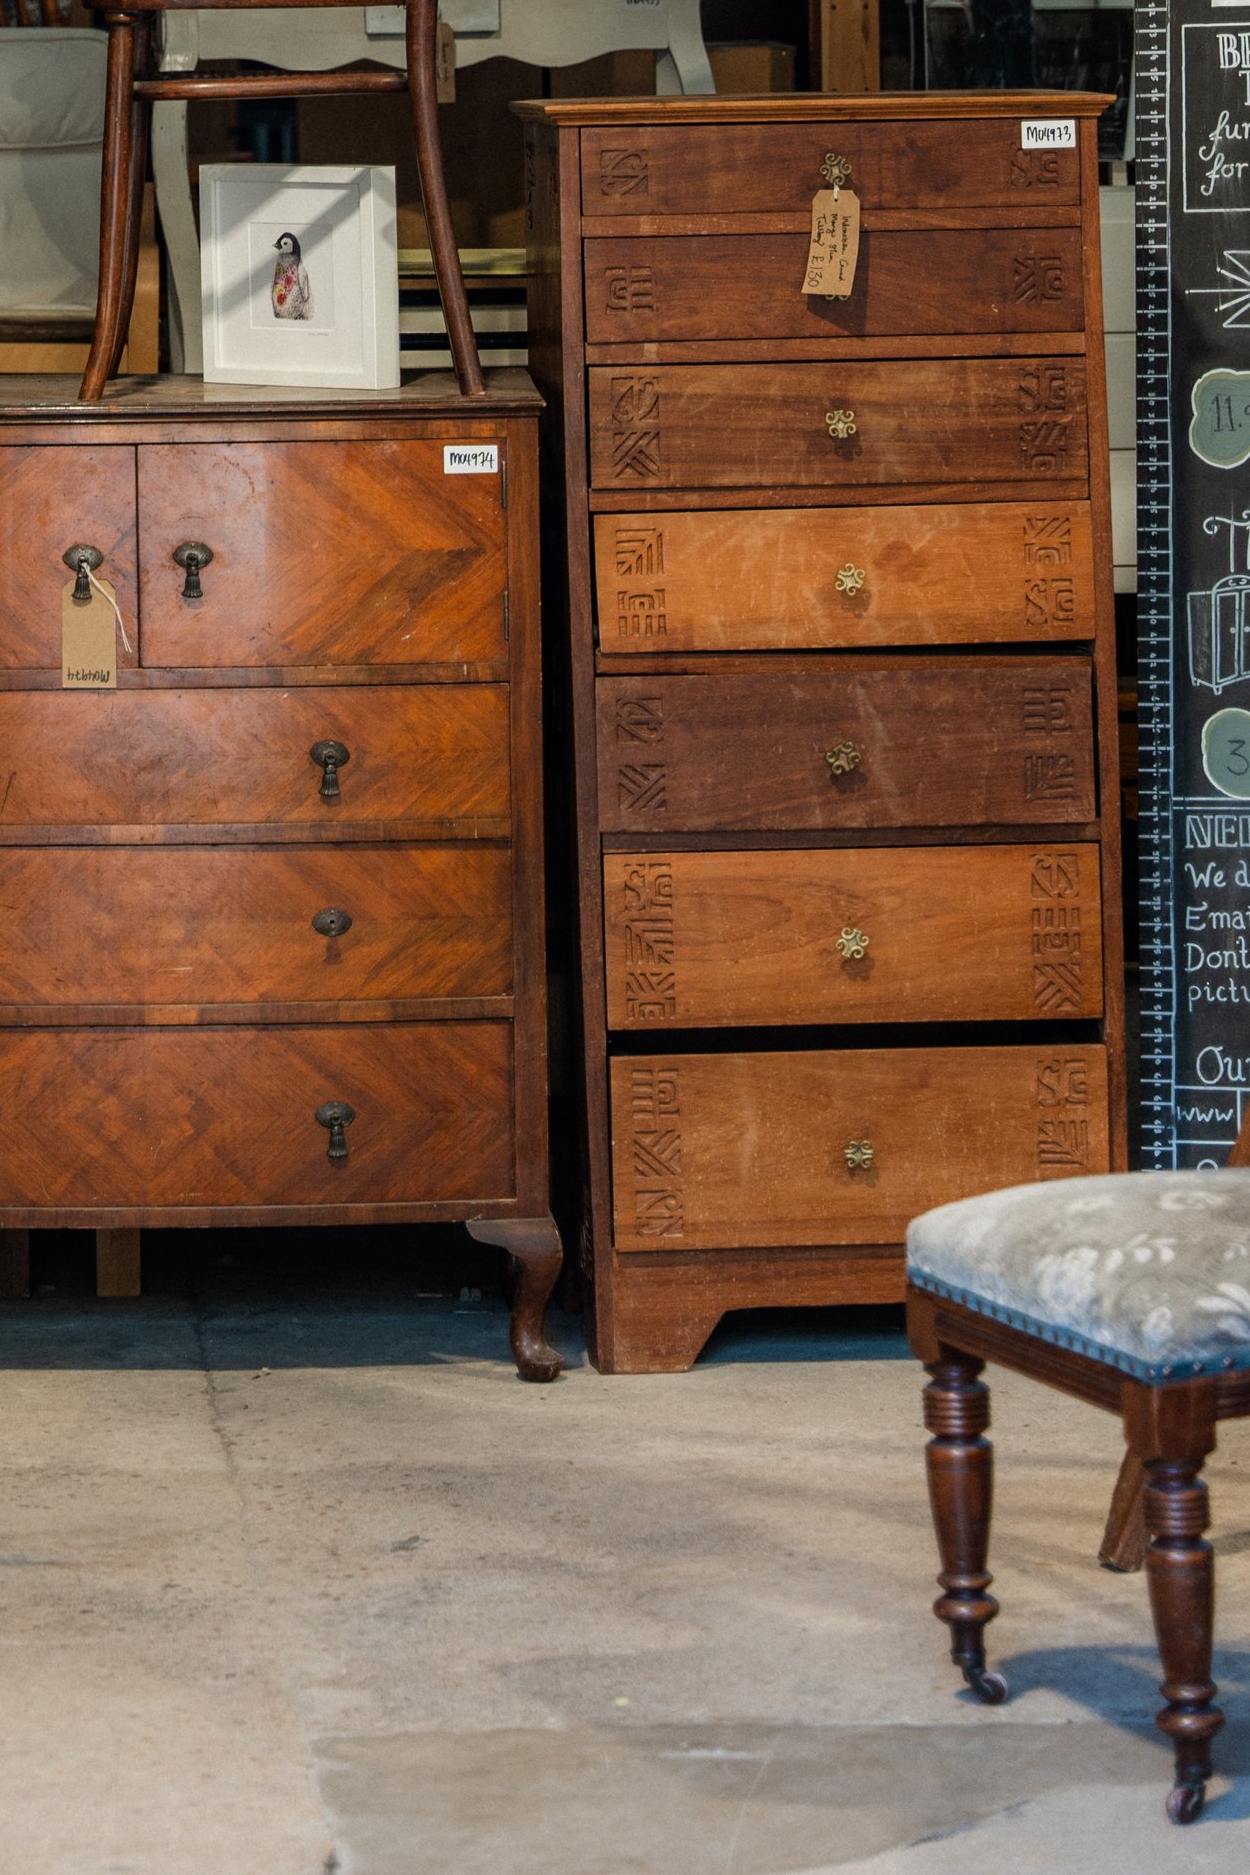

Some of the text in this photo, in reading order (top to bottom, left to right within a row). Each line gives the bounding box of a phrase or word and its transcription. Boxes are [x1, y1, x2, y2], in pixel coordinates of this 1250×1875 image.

[1148, 1, 1155, 17] 12
[1148, 23, 1157, 37] 13
[1149, 44, 1158, 60] 14
[1149, 66, 1158, 81] 15
[1150, 87, 1158, 101] 16
[1149, 109, 1158, 123] 17
[1026, 125, 1071, 142] M04973
[1149, 154, 1158, 167] 19
[1149, 174, 1157, 189] 20
[1200, 153, 1249, 196] for
[1148, 196, 1156, 209] 21
[1147, 218, 1155, 232] 22
[1148, 239, 1156, 254] 23
[807, 255, 824, 288] £130
[1184, 862, 1227, 888] We
[1176, 1106, 1234, 1122] www
